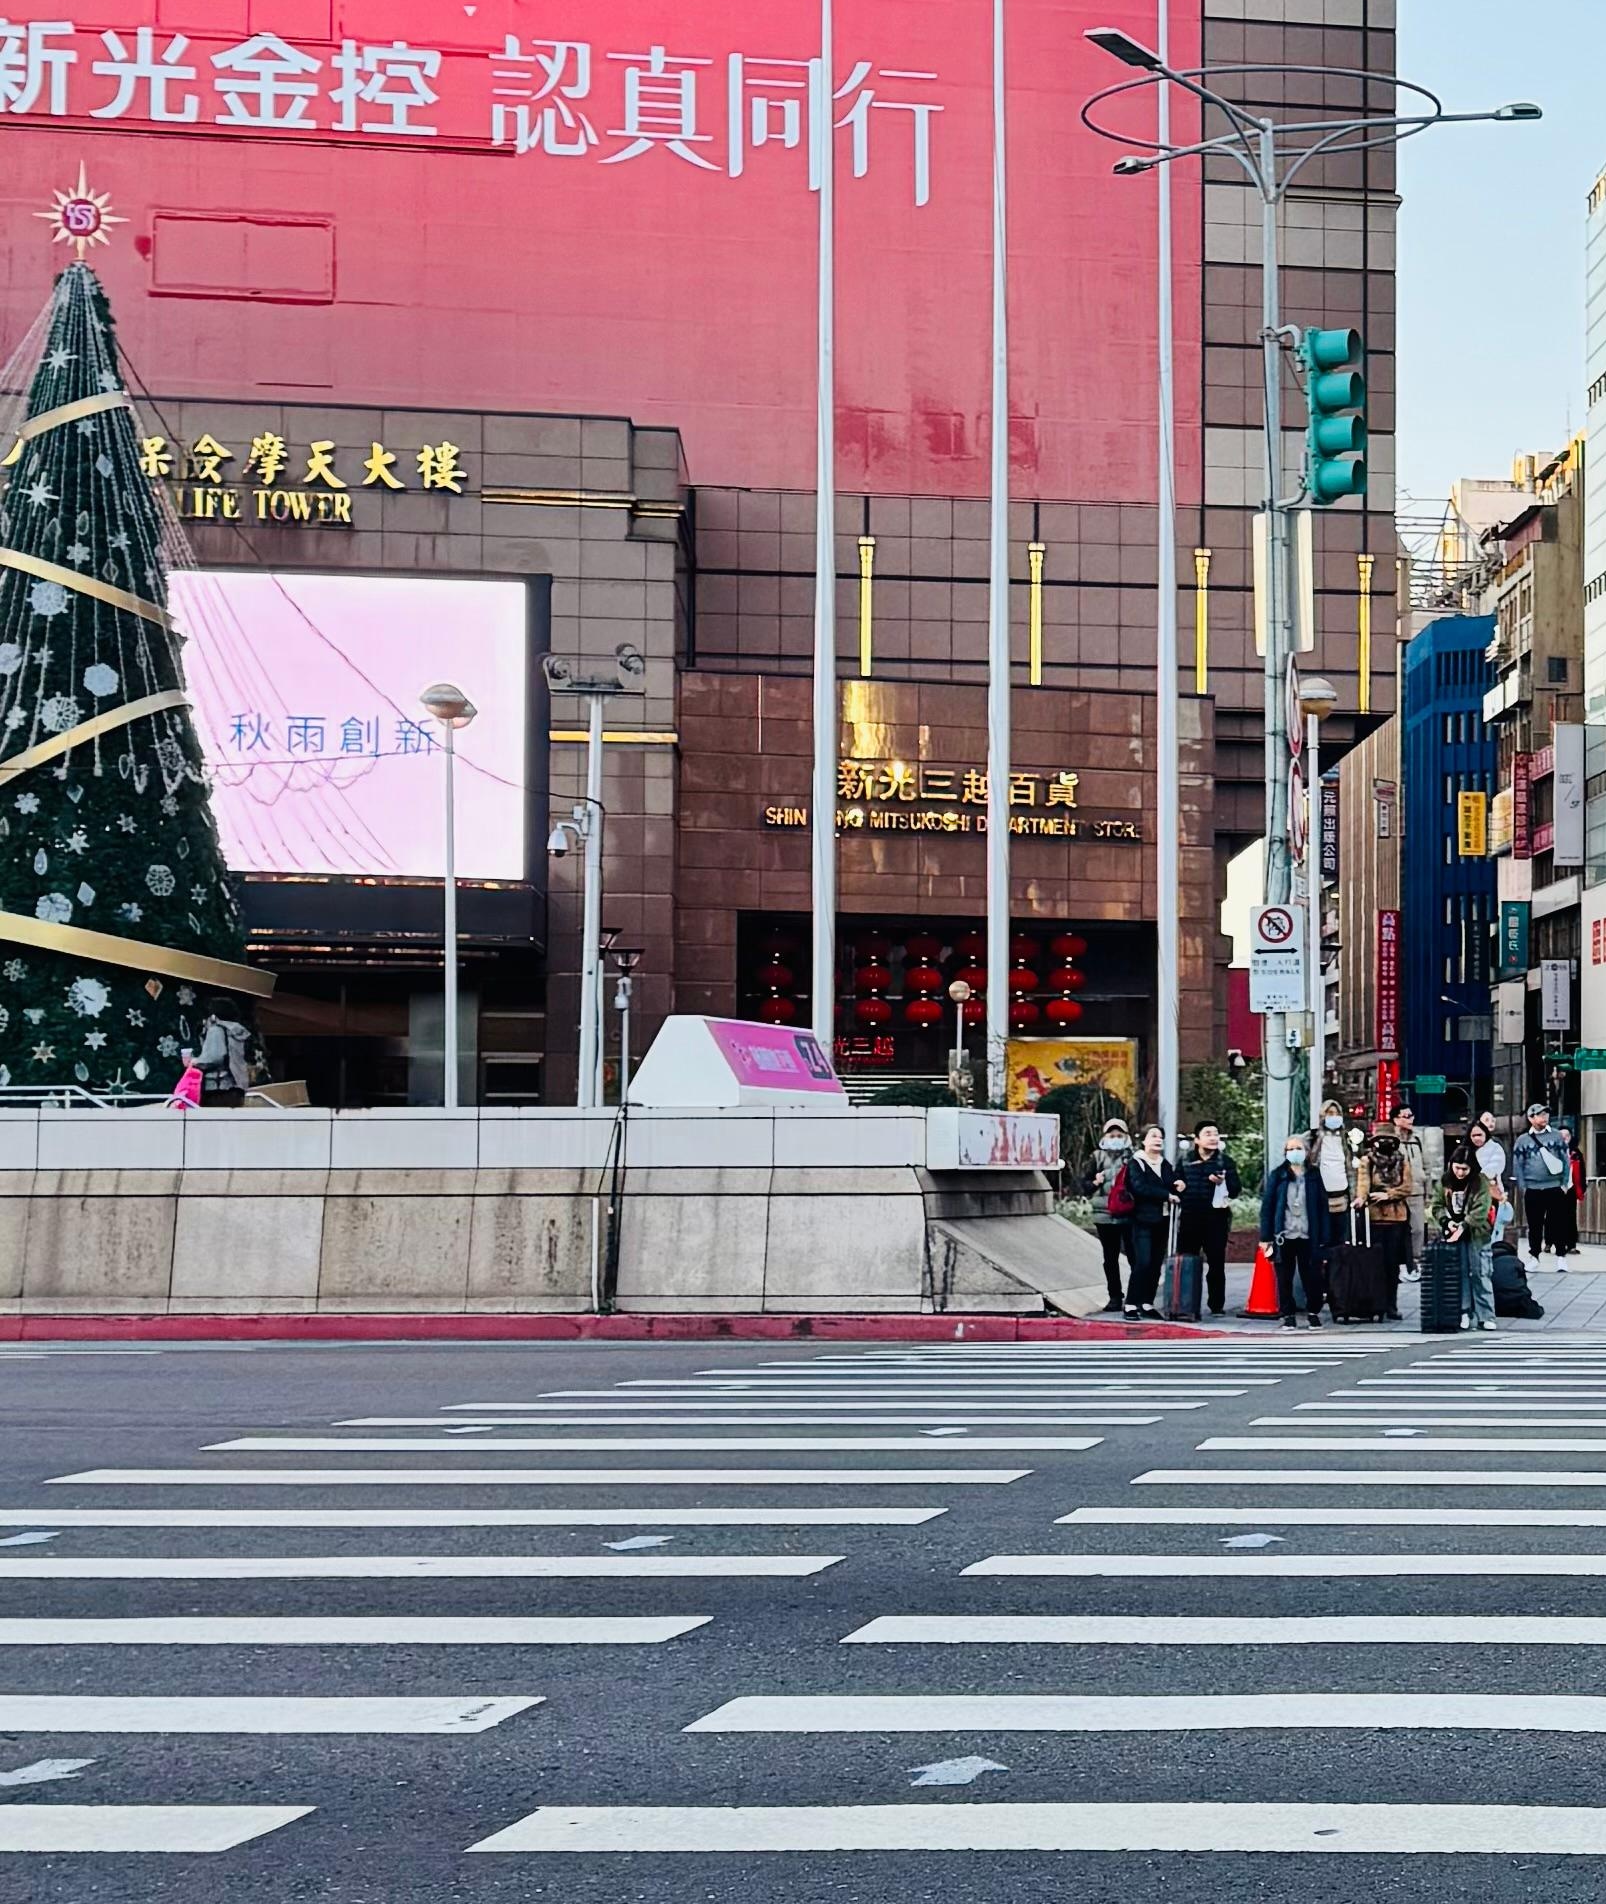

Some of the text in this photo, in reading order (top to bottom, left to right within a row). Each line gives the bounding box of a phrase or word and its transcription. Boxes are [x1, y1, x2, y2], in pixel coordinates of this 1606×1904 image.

[0, 17, 946, 208] 新光金控 認真同行
[176, 487, 353, 525] LIFE TOWER
[227, 711, 437, 757] 秋雨創新
[837, 758, 1080, 809] 新光三越百貨
[765, 806, 808, 827] SHIN
[976, 815, 1084, 837] DARTMENT
